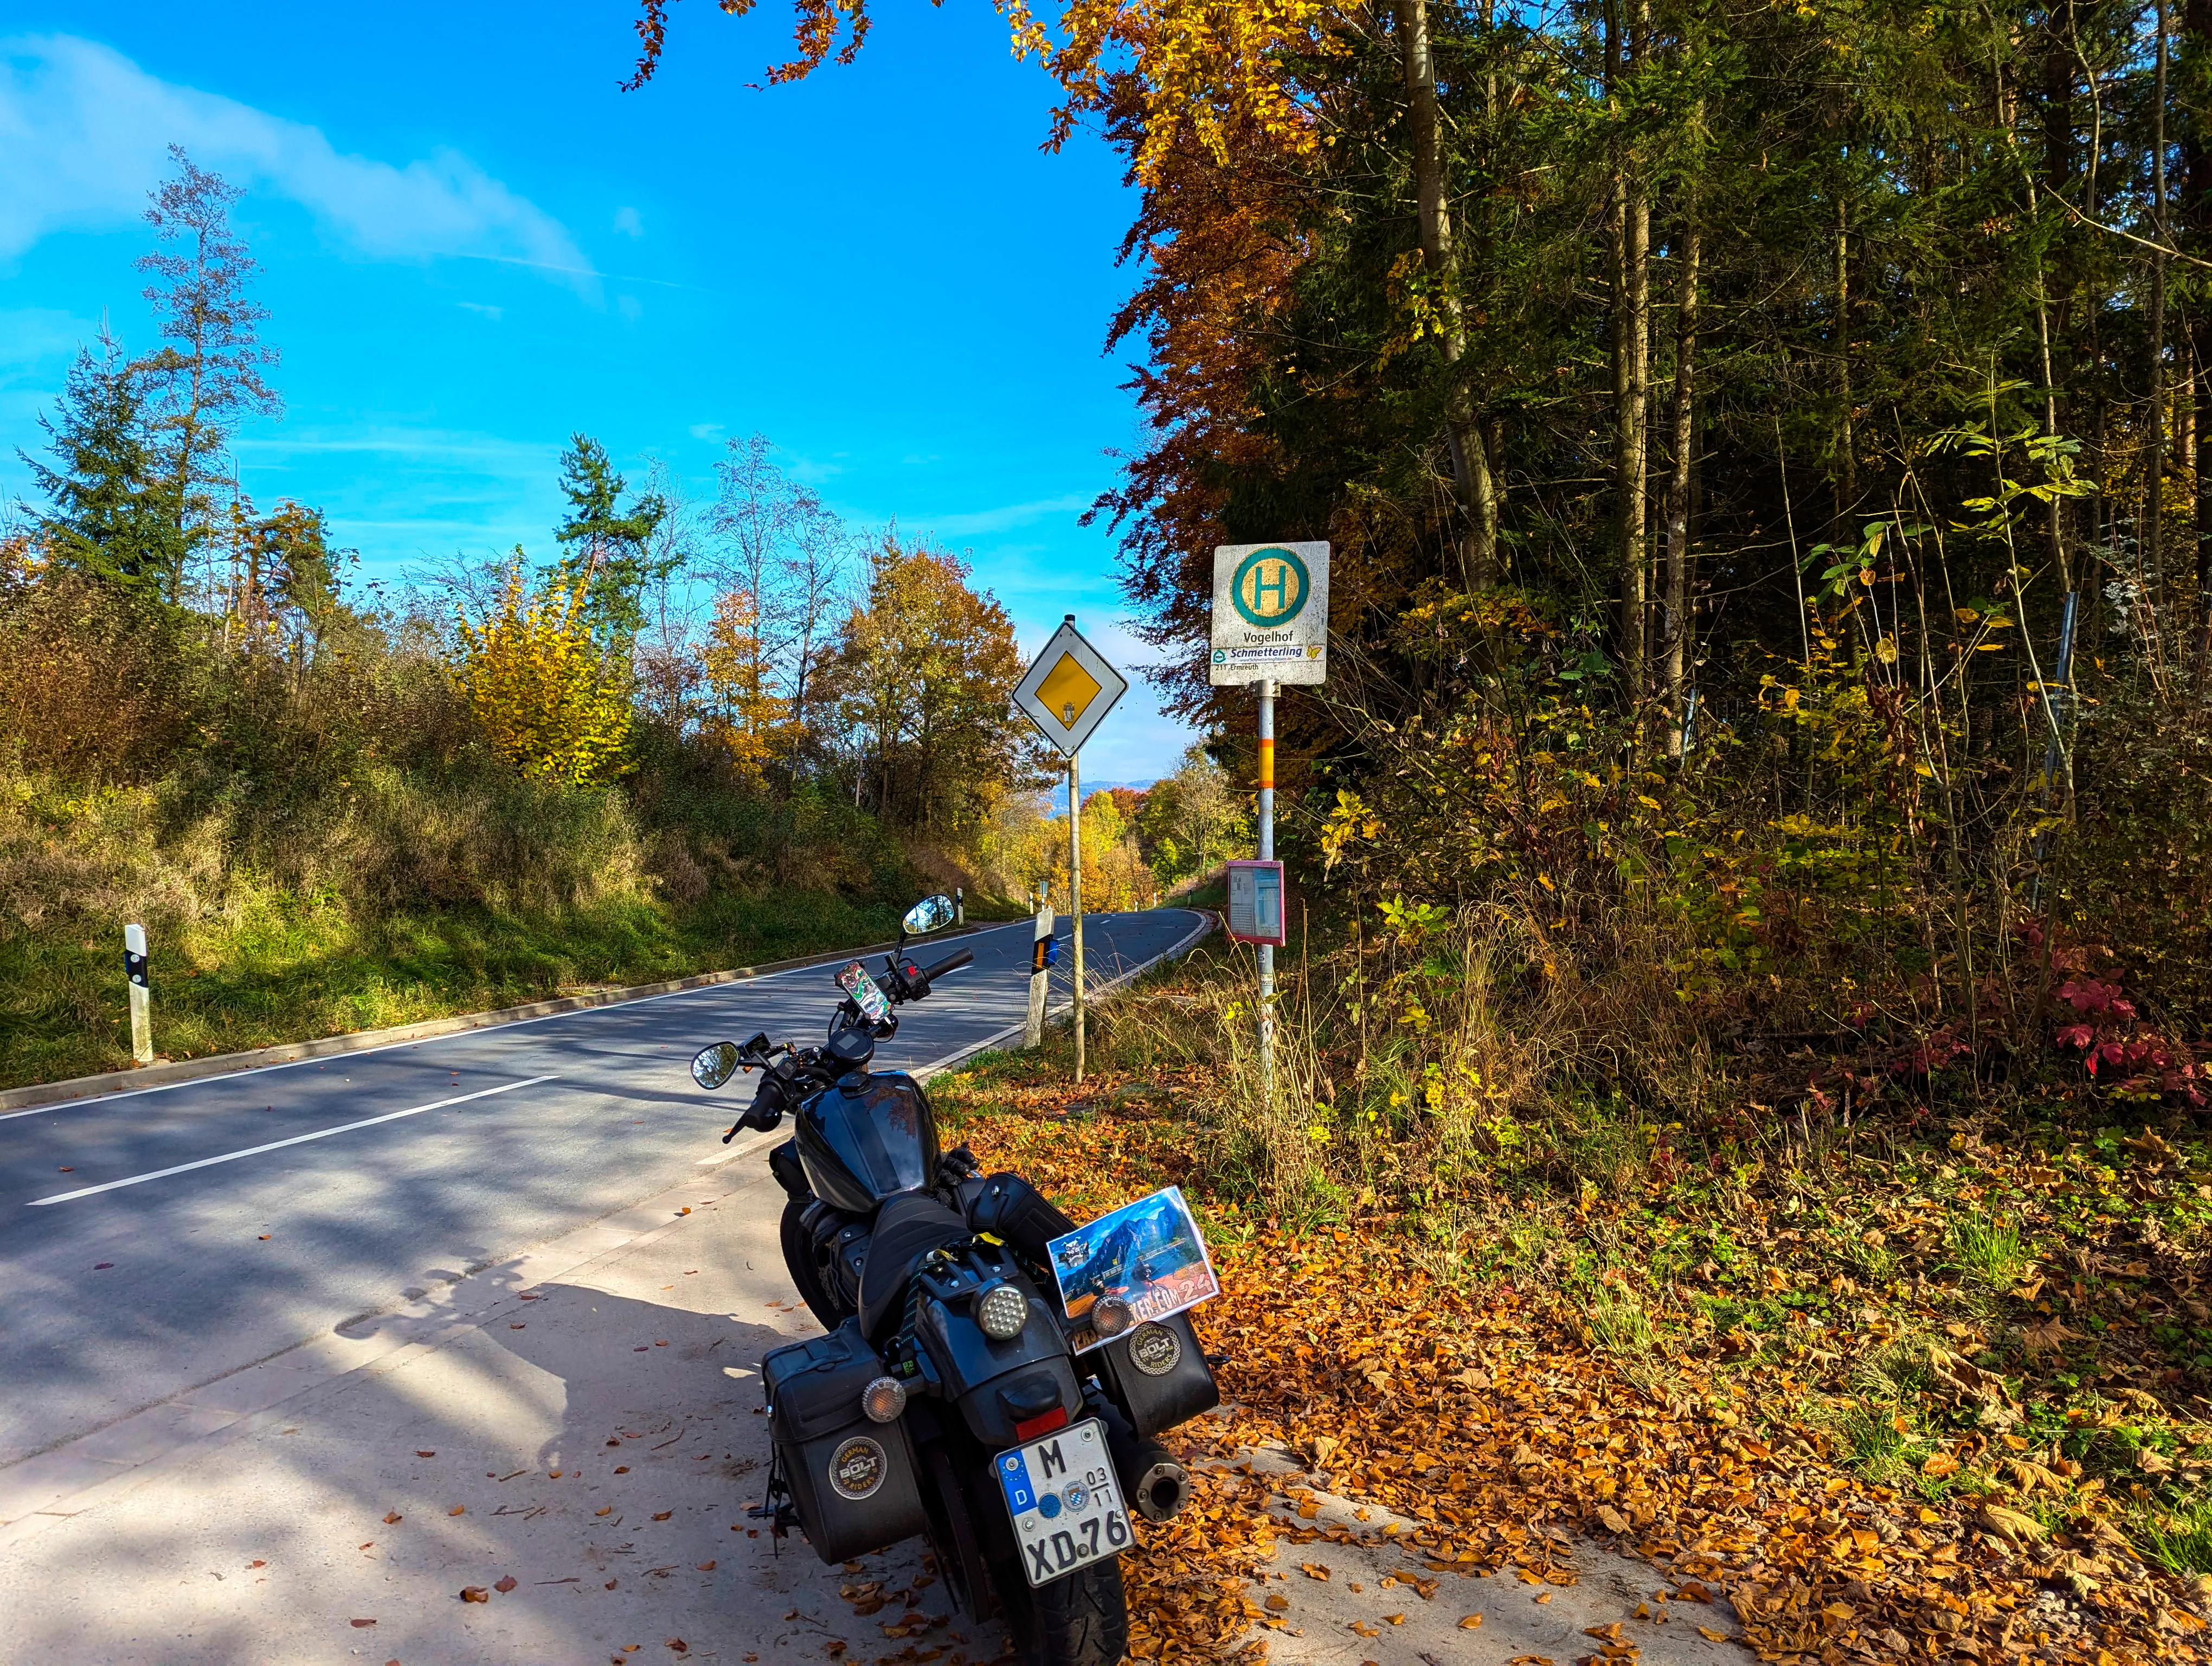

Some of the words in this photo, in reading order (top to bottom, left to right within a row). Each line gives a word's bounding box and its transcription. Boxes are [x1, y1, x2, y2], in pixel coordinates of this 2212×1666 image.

[1254, 565, 1287, 610] H
[1243, 631, 1294, 645] Vogelhof
[1230, 647, 1302, 658] Schmetterling
[1179, 1273, 1214, 1302] 24
[1136, 1329, 1163, 1345] GERMAN
[1139, 1337, 1169, 1359] BOLT
[1150, 1353, 1172, 1368] RIDERS
[841, 1446, 870, 1462] GERMAN
[1038, 1439, 1066, 1478] M
[839, 1456, 877, 1479] BOLT
[1086, 1467, 1107, 1485] 03
[850, 1476, 874, 1490] RIDERS
[1014, 1489, 1027, 1505] D
[1094, 1489, 1113, 1507] 11
[1026, 1530, 1077, 1580] XD
[1080, 1510, 1127, 1556] 76
